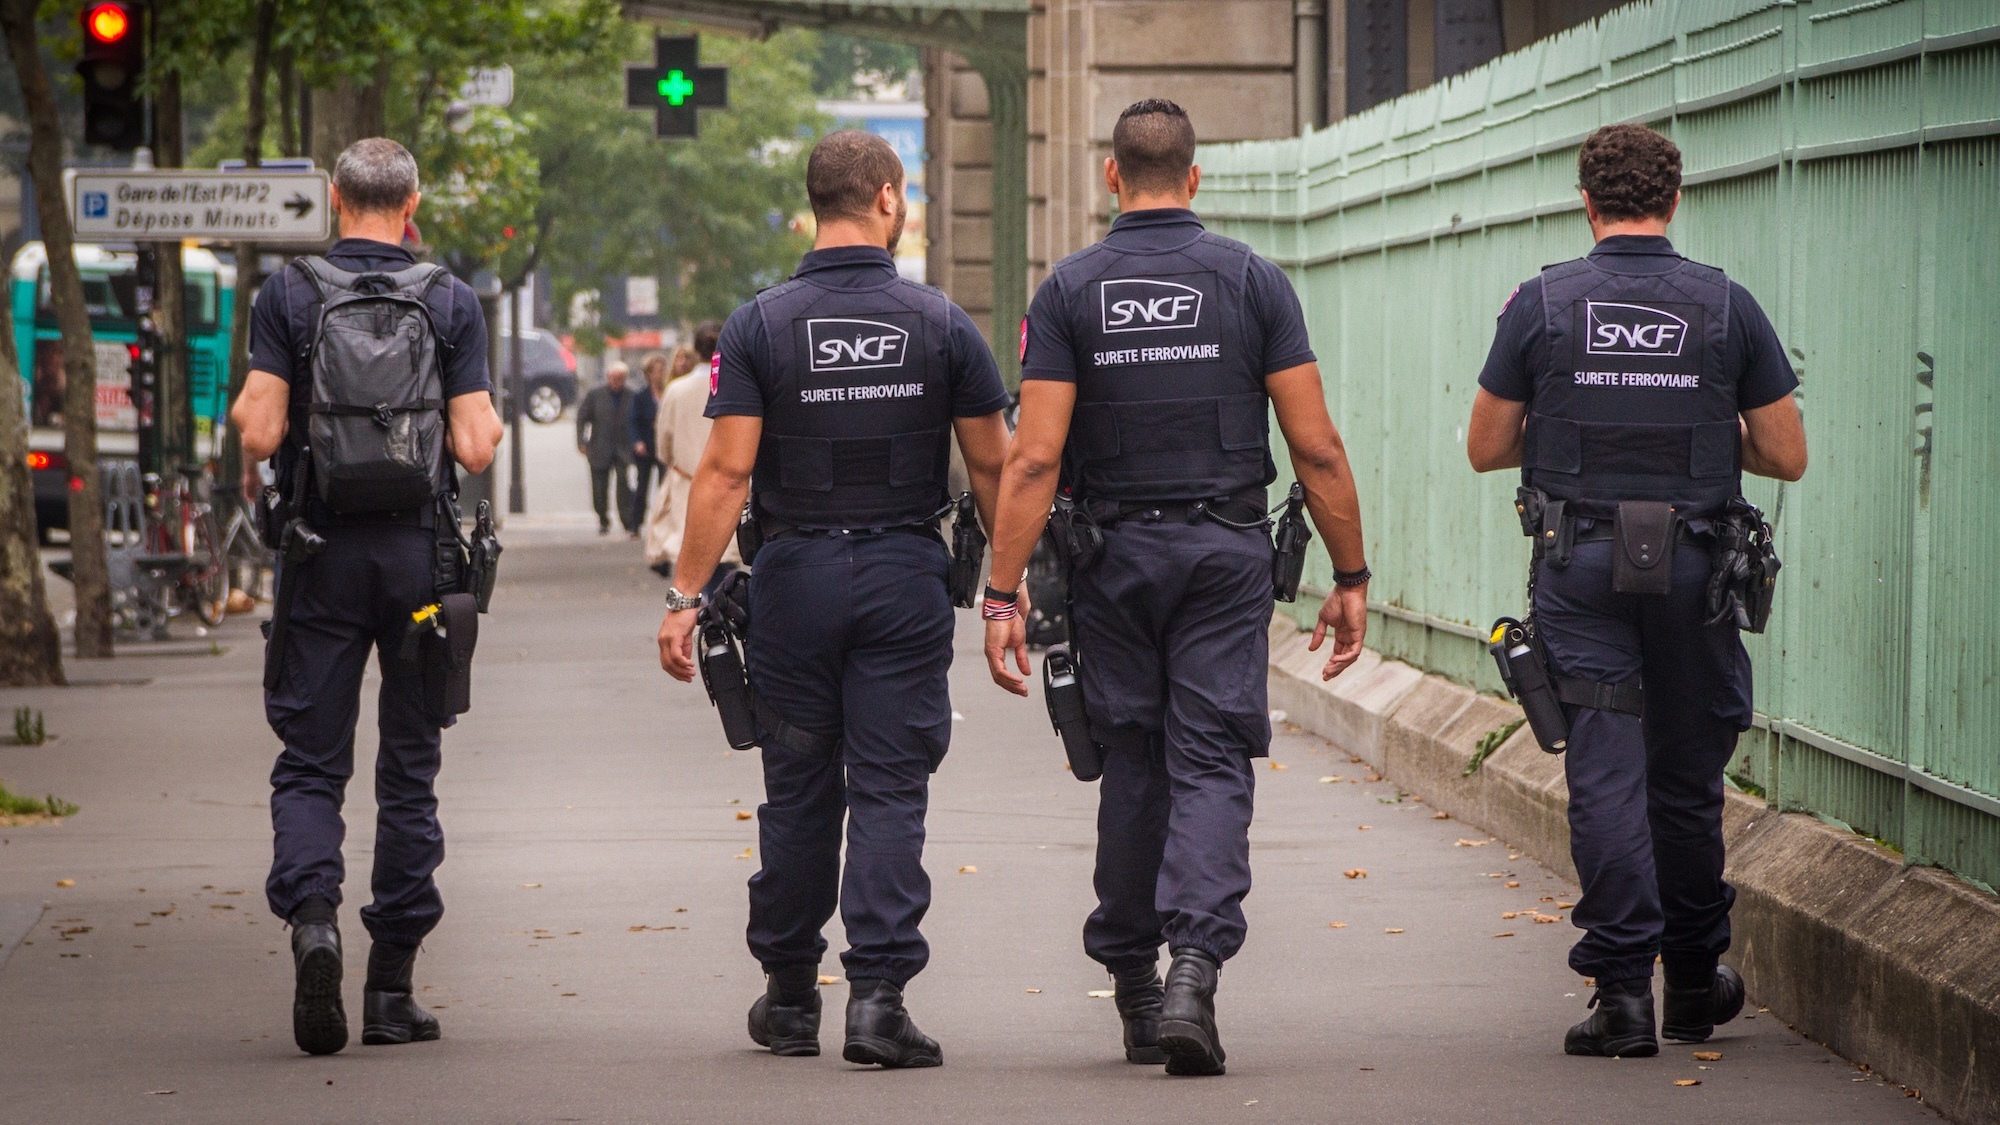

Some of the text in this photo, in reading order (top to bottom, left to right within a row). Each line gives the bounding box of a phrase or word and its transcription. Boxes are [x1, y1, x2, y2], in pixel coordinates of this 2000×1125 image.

[117, 183, 157, 202] Gare
[161, 184, 180, 202] de
[182, 182, 217, 202] l'Est
[116, 208, 280, 233] Dépose Minute
[1108, 295, 1195, 326] SNCF
[1592, 324, 1680, 348] SNCF
[816, 334, 901, 364] SNCF
[1094, 344, 1220, 366] SURETE FERROVIAIRE
[1574, 371, 1699, 388] SURETE FERROVIAIRE
[800, 383, 925, 403] SURETE FERROVIAIRE
